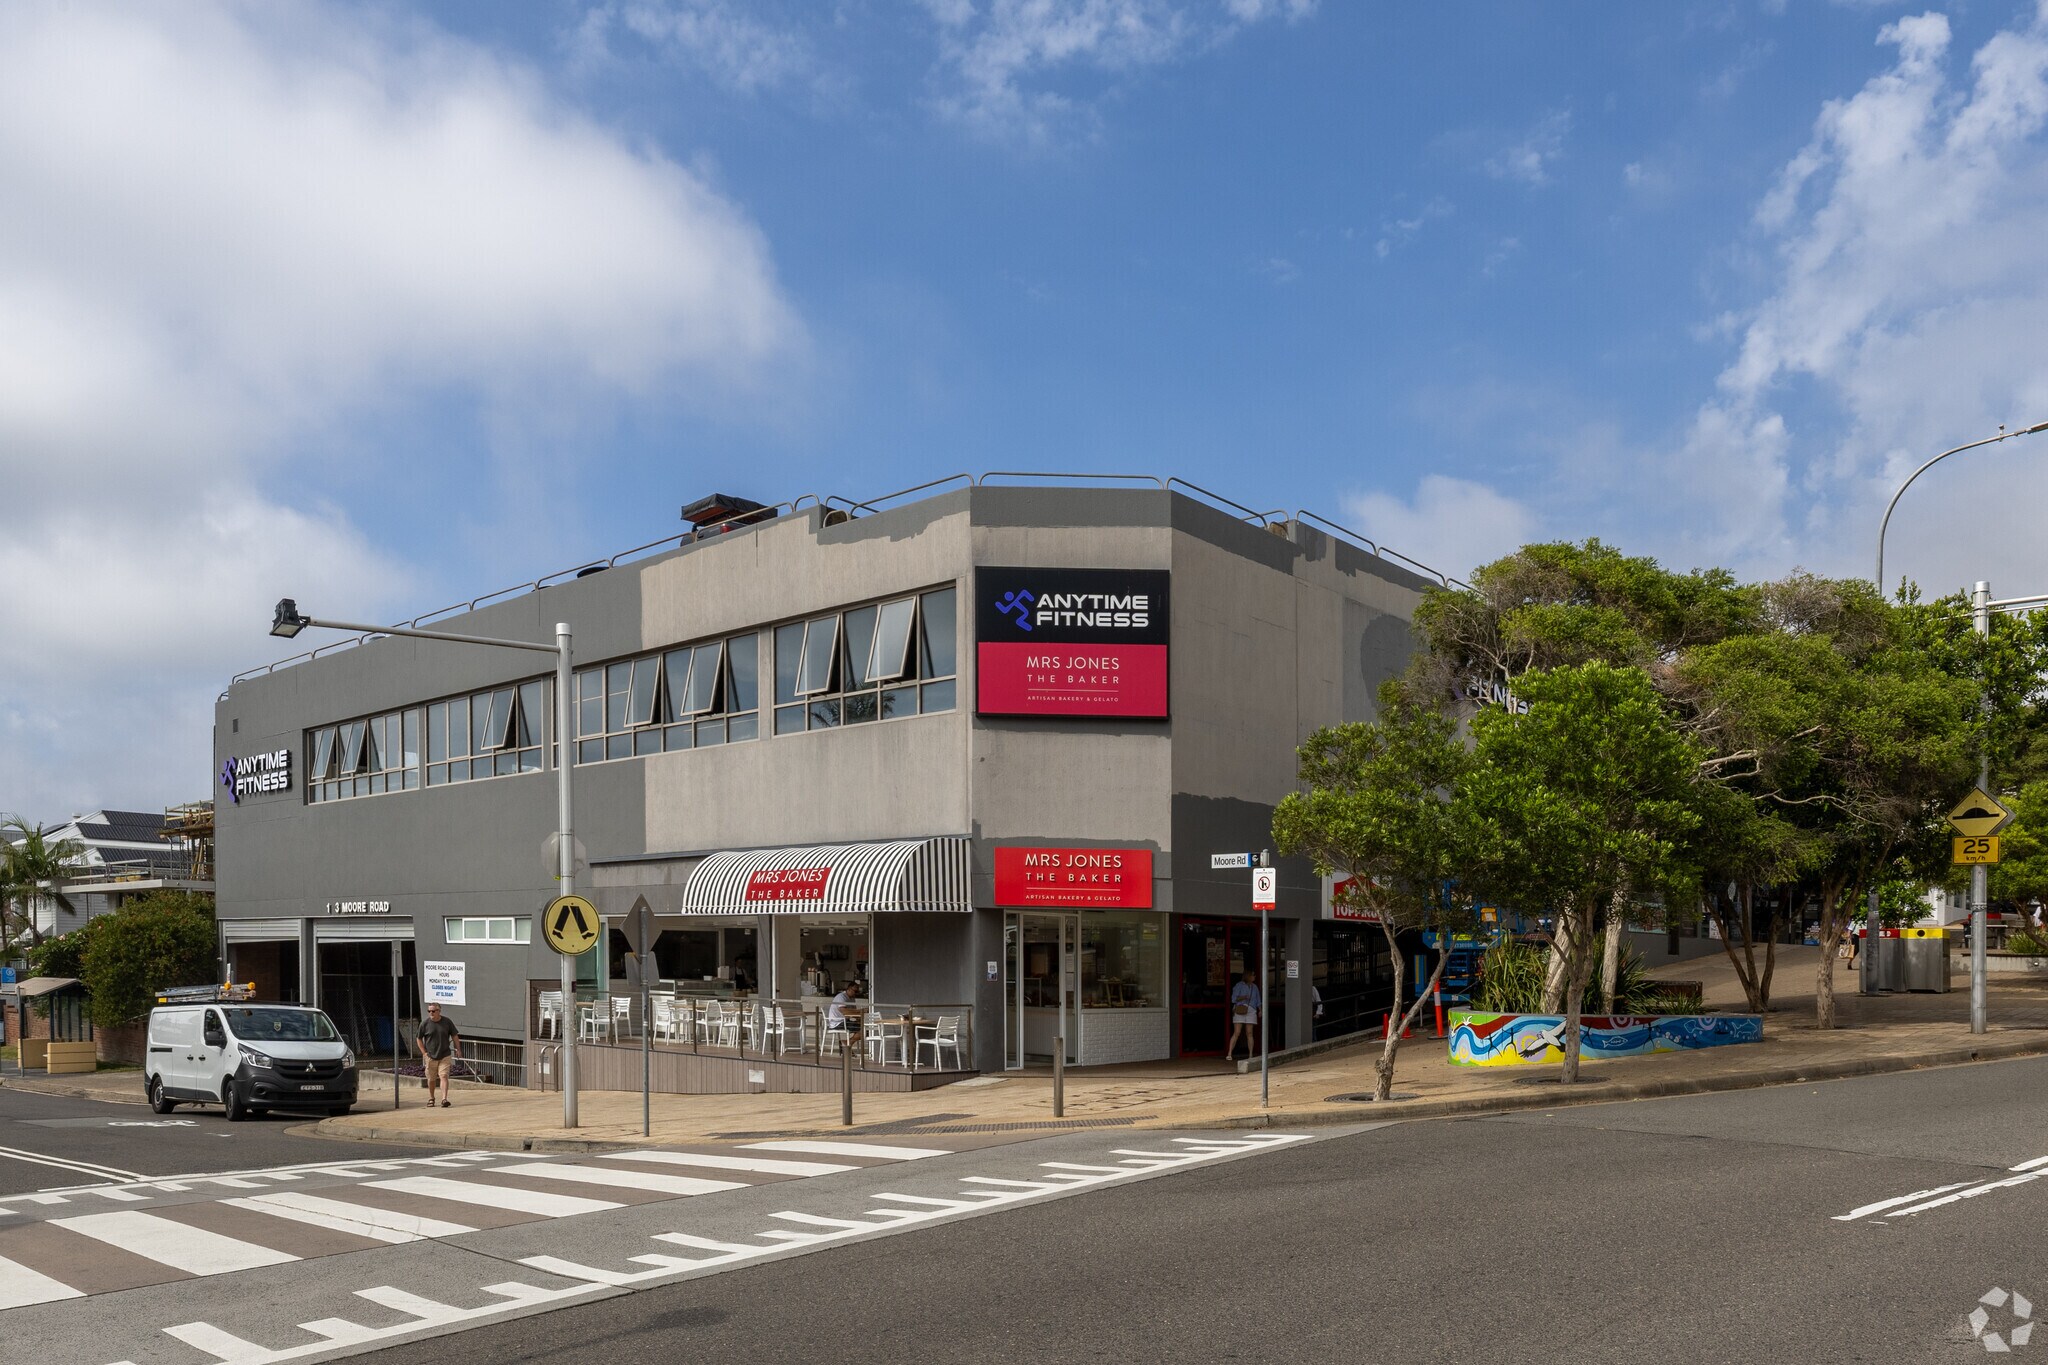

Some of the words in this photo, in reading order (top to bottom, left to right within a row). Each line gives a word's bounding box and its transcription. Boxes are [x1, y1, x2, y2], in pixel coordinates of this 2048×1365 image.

[1037, 594, 1148, 610] ANYTIME
[1037, 611, 1149, 627] FITNESS
[1026, 656, 1060, 669] MRS
[1065, 657, 1119, 670] JONES
[1027, 674, 1056, 683] THE
[1067, 675, 1119, 684] BAKER
[236, 749, 287, 776] ANYTIME
[236, 770, 288, 796] FITNESS
[1963, 839, 1990, 854] 25
[1025, 853, 1060, 867] MRS
[1066, 854, 1122, 868] JONES
[1214, 857, 1235, 866] Moore
[1236, 856, 1246, 865] Rd
[753, 871, 780, 884] MRS
[781, 868, 824, 883] JONES
[1026, 872, 1056, 882] THE
[1068, 873, 1121, 883] BAKER
[751, 890, 772, 899] THE
[780, 888, 819, 898] BAKER
[326, 902, 330, 914] 1
[334, 902, 340, 913] 3
[341, 901, 367, 913] MOORE
[369, 901, 390, 913] ROAD
